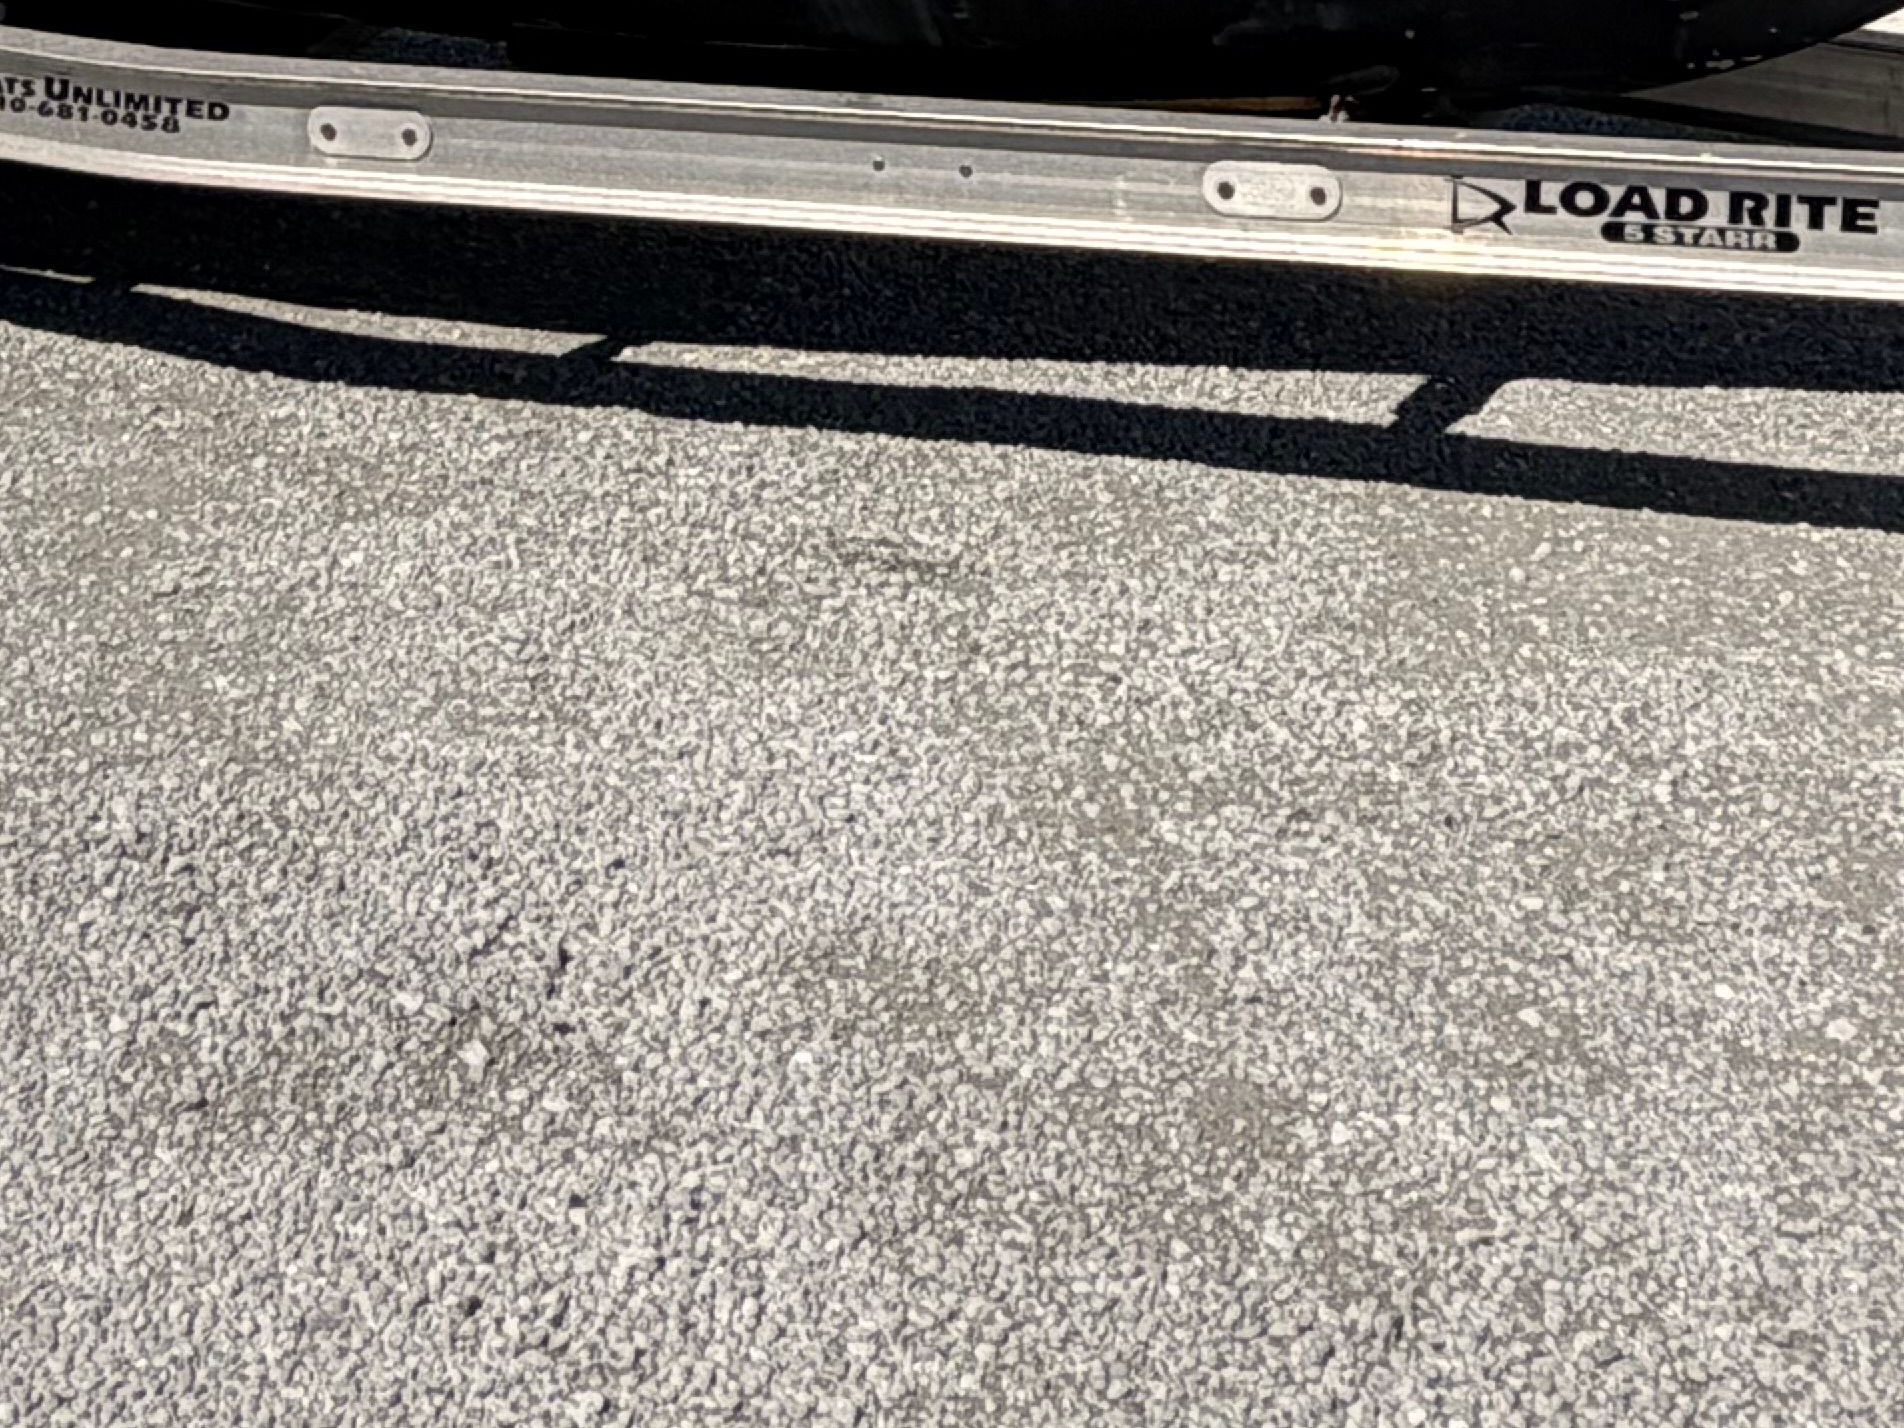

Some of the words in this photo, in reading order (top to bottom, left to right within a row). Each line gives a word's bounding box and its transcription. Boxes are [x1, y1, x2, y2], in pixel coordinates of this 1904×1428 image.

[1523, 178, 1710, 223] LOAD
[1727, 190, 1880, 235] RITE
[1622, 224, 1644, 243] 5
